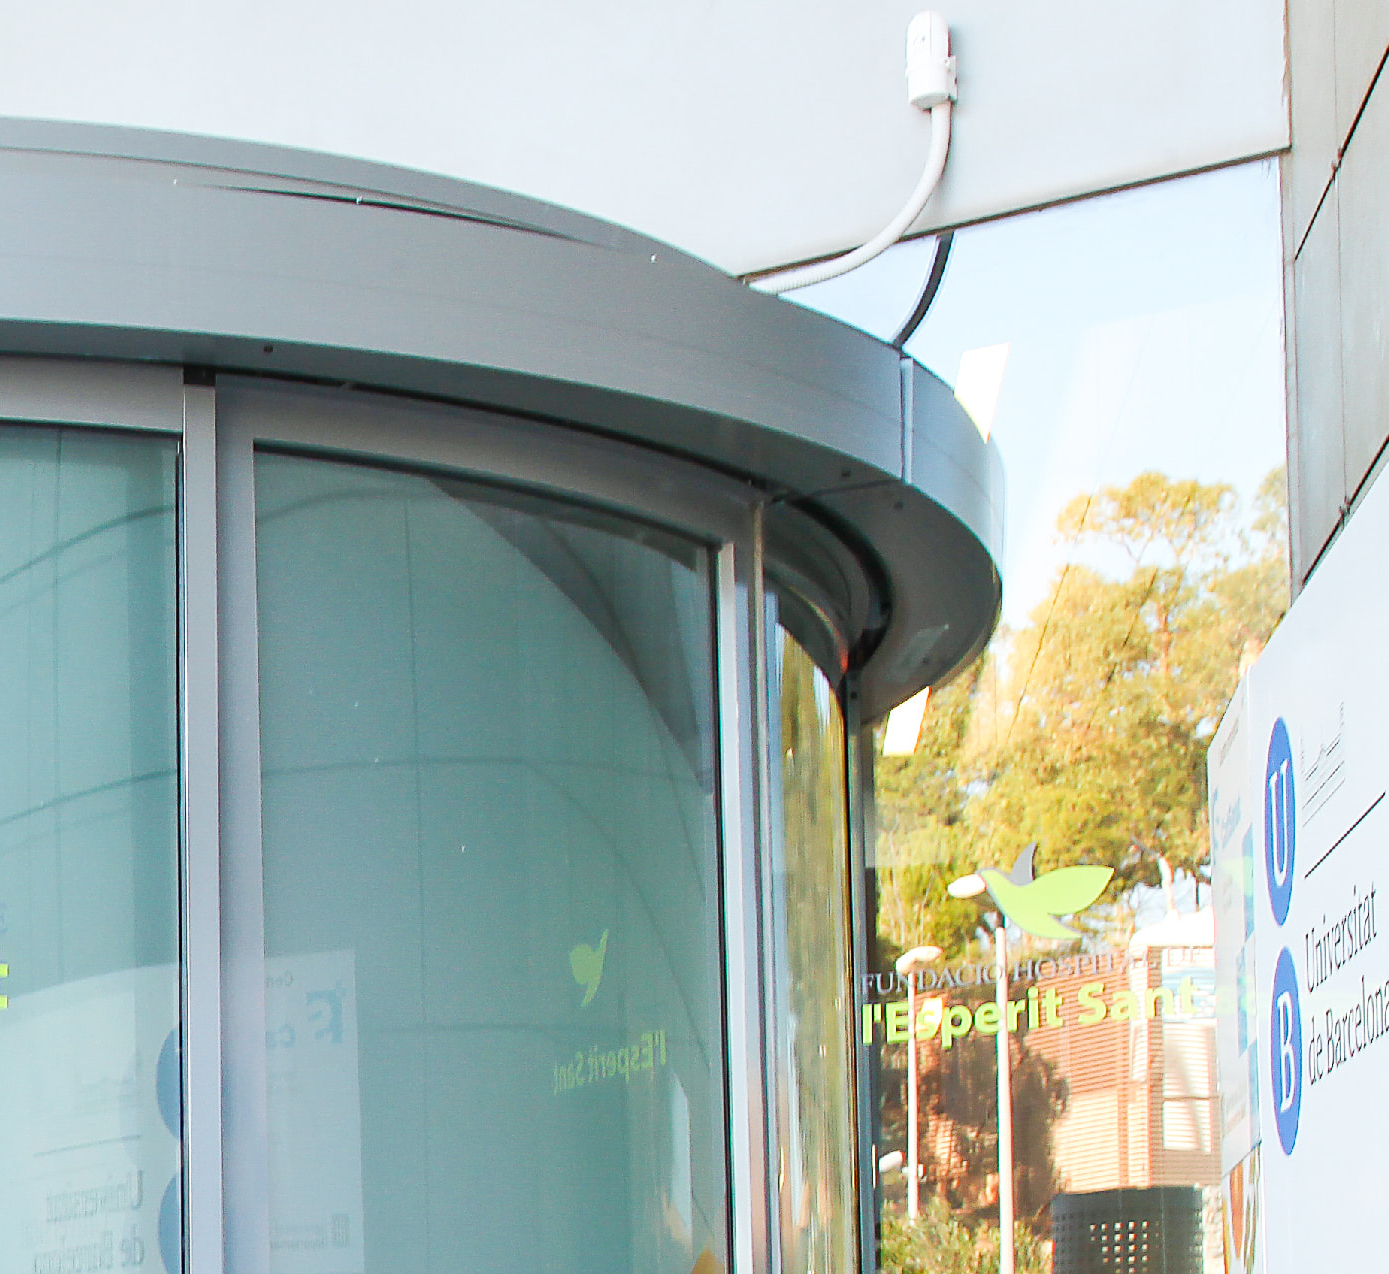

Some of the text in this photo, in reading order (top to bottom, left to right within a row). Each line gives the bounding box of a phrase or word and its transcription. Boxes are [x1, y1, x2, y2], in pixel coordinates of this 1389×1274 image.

[1305, 880, 1377, 994] Universitat
[1078, 976, 1199, 1026] Sant
[1308, 974, 1389, 1086] de Barcelona
